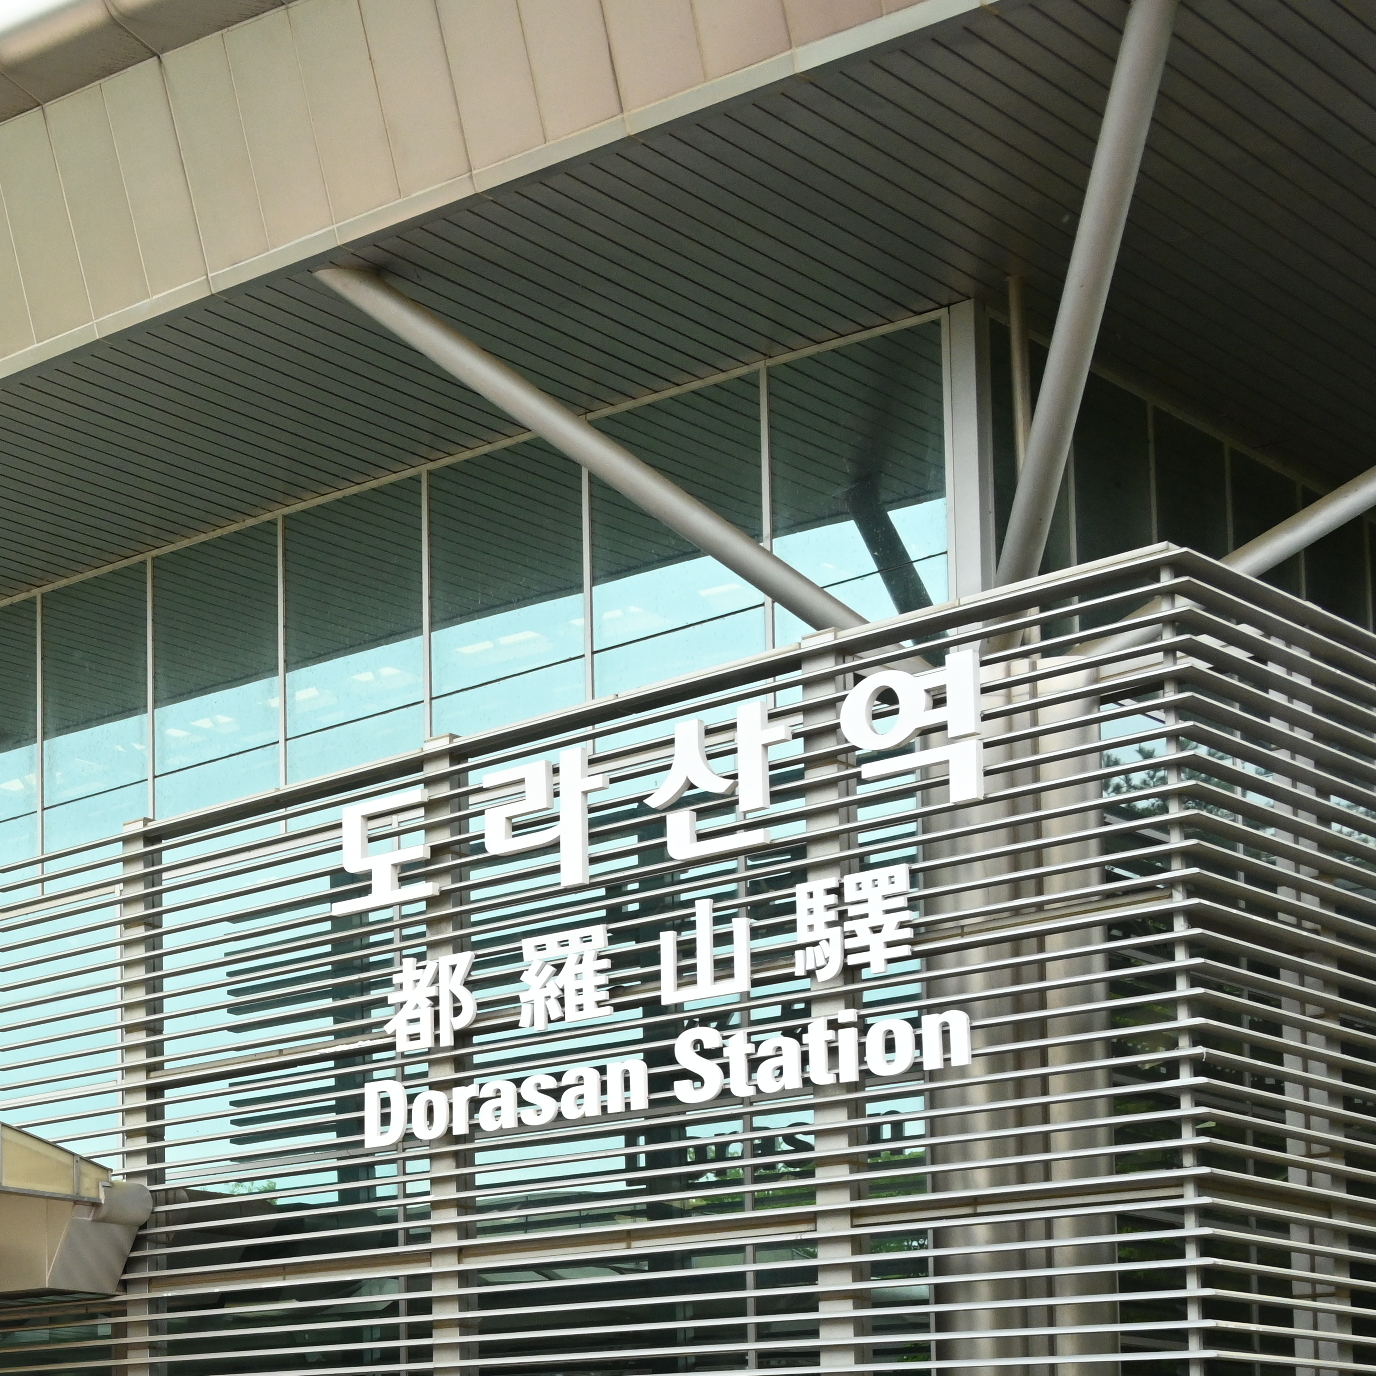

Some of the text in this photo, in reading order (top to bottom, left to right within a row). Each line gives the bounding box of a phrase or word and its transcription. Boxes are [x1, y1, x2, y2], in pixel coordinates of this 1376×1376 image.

[331, 647, 986, 918] 도라산역
[385, 864, 915, 1054] 都羅山驛
[364, 1057, 650, 1149] Dorasan
[673, 1007, 972, 1104] Station
